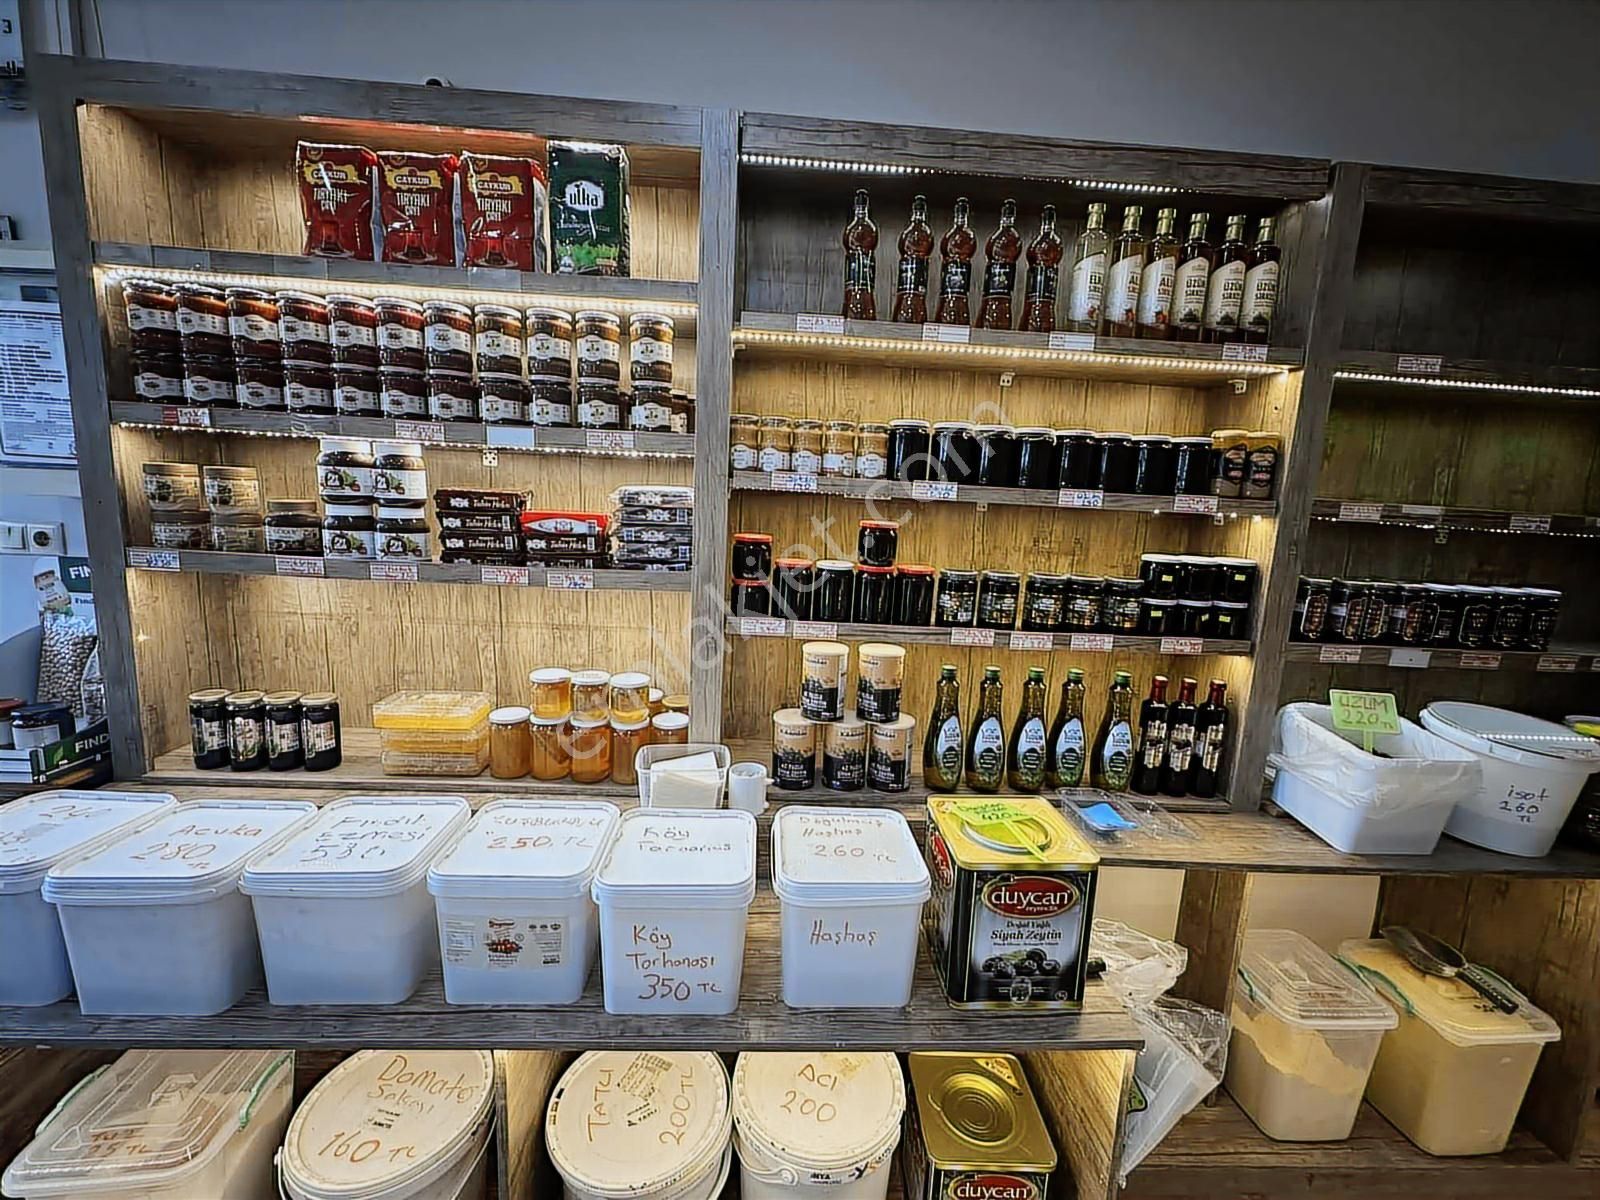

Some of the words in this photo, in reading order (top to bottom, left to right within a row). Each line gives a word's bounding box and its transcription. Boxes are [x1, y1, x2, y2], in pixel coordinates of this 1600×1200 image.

[814, 844, 865, 857] 260
[991, 886, 1069, 909] duycan
[633, 925, 672, 950] Köy
[990, 929, 1024, 942] Siyah
[1024, 928, 1062, 942] Zeytin
[638, 973, 691, 1001] 350
[780, 1090, 836, 1122] 200
[318, 1130, 381, 1163] 160
[957, 1182, 1029, 1200] duycan
